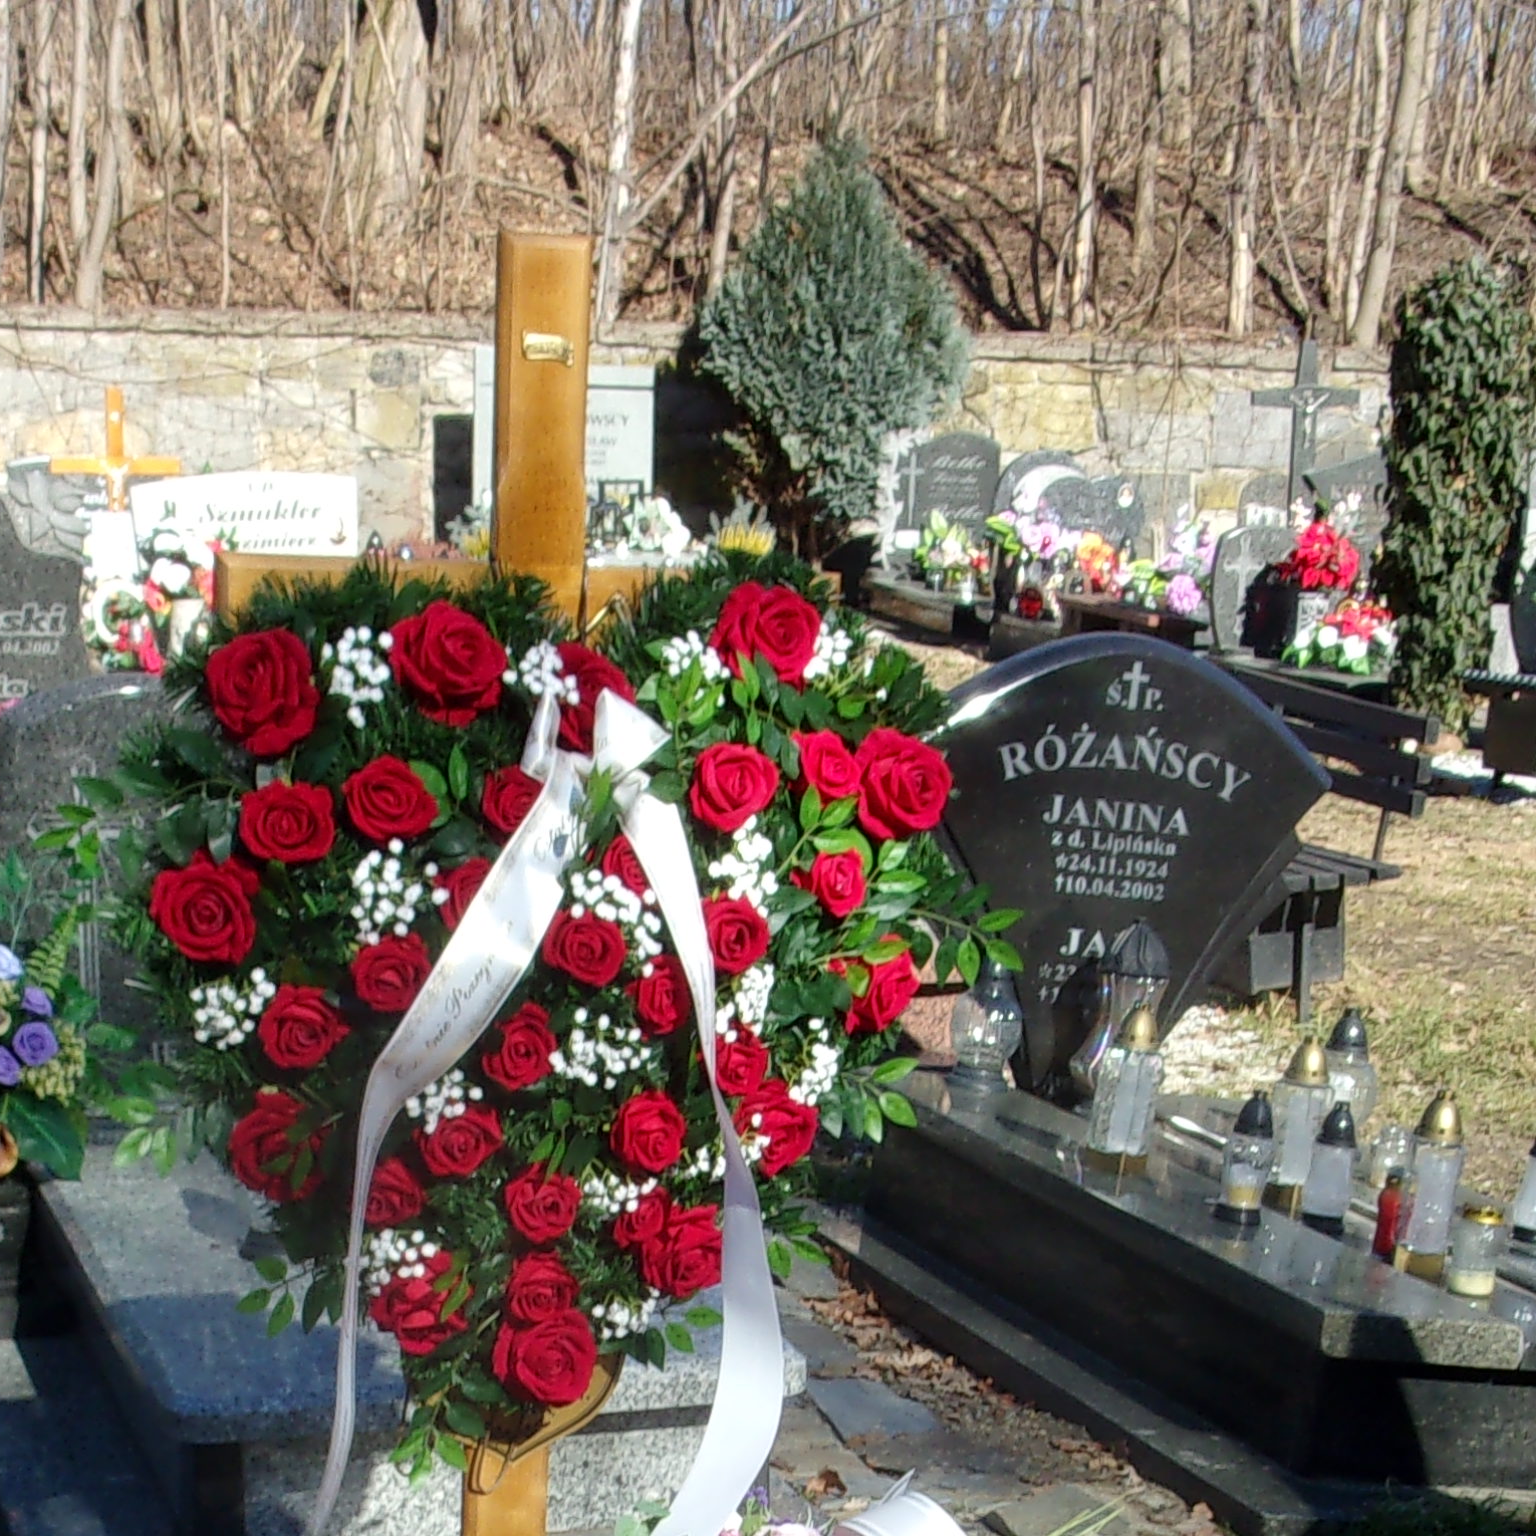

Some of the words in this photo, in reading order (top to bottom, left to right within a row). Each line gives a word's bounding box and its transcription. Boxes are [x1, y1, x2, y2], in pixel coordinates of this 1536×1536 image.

[997, 722, 1252, 803] RÓŻAŃSCY
[1042, 794, 1190, 836] JANINA
[1050, 830, 1064, 847] z
[1067, 828, 1086, 849] d.
[1091, 829, 1177, 856] Lipińska
